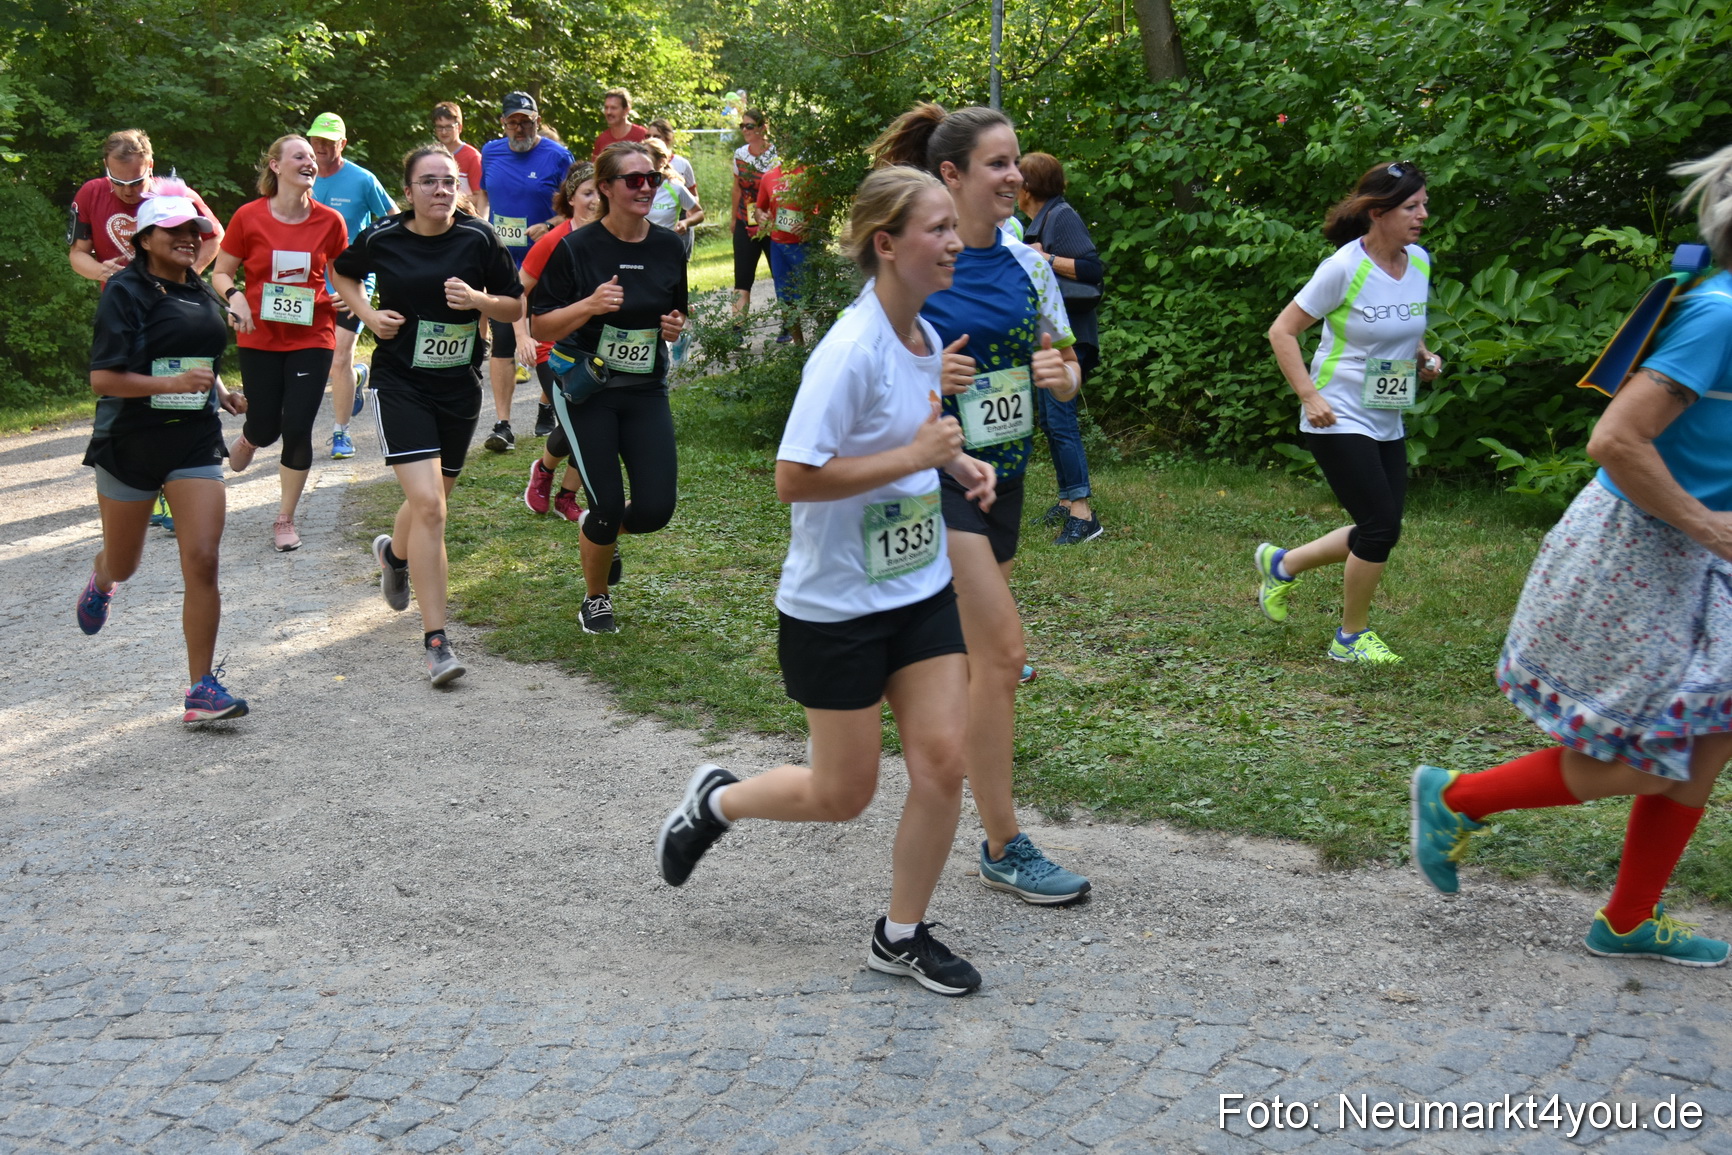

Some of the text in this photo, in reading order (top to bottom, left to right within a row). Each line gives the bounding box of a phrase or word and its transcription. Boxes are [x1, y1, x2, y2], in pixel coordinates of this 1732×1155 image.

[496, 225, 522, 239] 2030
[273, 298, 302, 314] 535
[422, 338, 468, 356] 2001
[607, 342, 650, 362] 1982
[1376, 377, 1408, 396] 924
[980, 394, 1023, 426] 202
[877, 518, 934, 558] 1333
